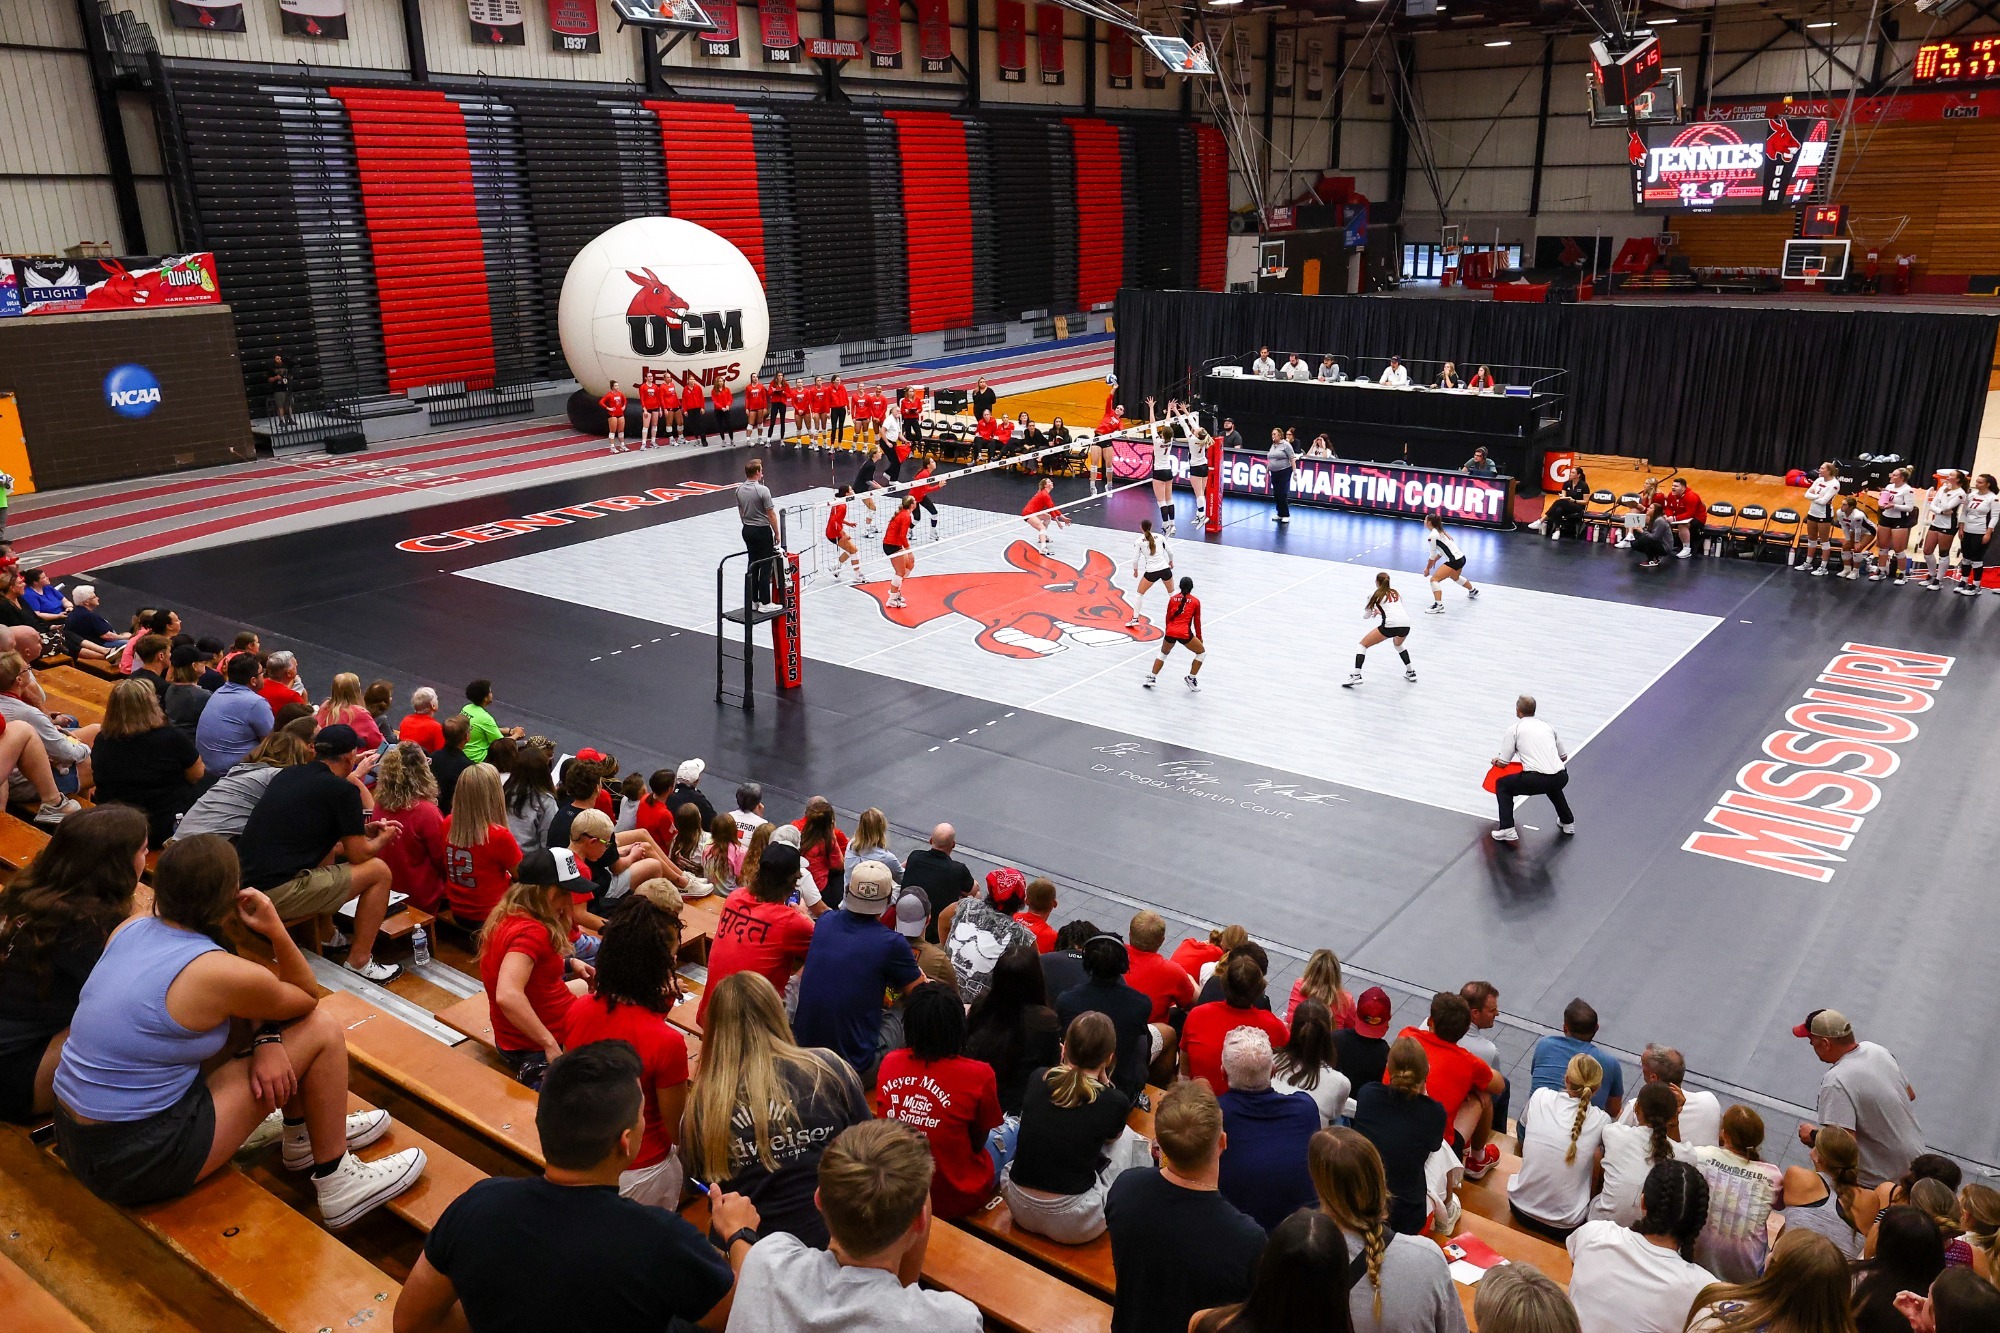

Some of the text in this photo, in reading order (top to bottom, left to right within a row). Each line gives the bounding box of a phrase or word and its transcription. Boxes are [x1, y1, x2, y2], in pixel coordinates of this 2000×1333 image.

[563, 36, 587, 50] 1937
[708, 43, 730, 55] 1938
[813, 41, 832, 54] GENERAL
[771, 49, 790, 61] 1984
[876, 56, 893, 66] 1984
[1636, 49, 1659, 74] 1:15
[927, 61, 943, 71] 2014
[1732, 105, 1767, 113] COLLISION
[1943, 106, 1979, 119] UCM
[1648, 143, 1764, 183] JENNIES
[1659, 169, 1756, 182] VOLLEYBALL
[1767, 164, 1784, 202] UCM
[1680, 183, 1697, 197] 22
[1709, 182, 1725, 196] 17
[1817, 211, 1837, 221] 1:15
[32, 288, 78, 299] FLIGHT
[626, 308, 745, 357] UCM
[632, 362, 741, 389] JENNIES
[111, 387, 162, 407] NCAA
[1549, 458, 1572, 483] G
[1837, 475, 1854, 483] olten
[1222, 460, 1267, 489] EGG
[1290, 468, 1397, 504] MARTIN
[1404, 480, 1504, 515] COURT
[1593, 493, 1613, 501] UCM
[1711, 504, 1732, 513] UCM
[1742, 507, 1764, 516] UCM
[1775, 511, 1797, 520] UCM
[395, 480, 739, 553] CENTRAL
[786, 580, 798, 682] JENNIES
[1680, 641, 1956, 884] MISSOURI
[1091, 763, 1294, 821] Dr. Peggy Martin Court
[446, 846, 476, 889] 12
[881, 1075, 951, 1108] Meyer Music
[902, 1095, 933, 1111] Music
[898, 1109, 941, 1128] Smarter
[730, 1124, 834, 1158] dweiser
[1710, 1158, 1733, 1172] TRACK
[1740, 1168, 1763, 1180] FIELD
[985, 1195, 1003, 1210] 8
